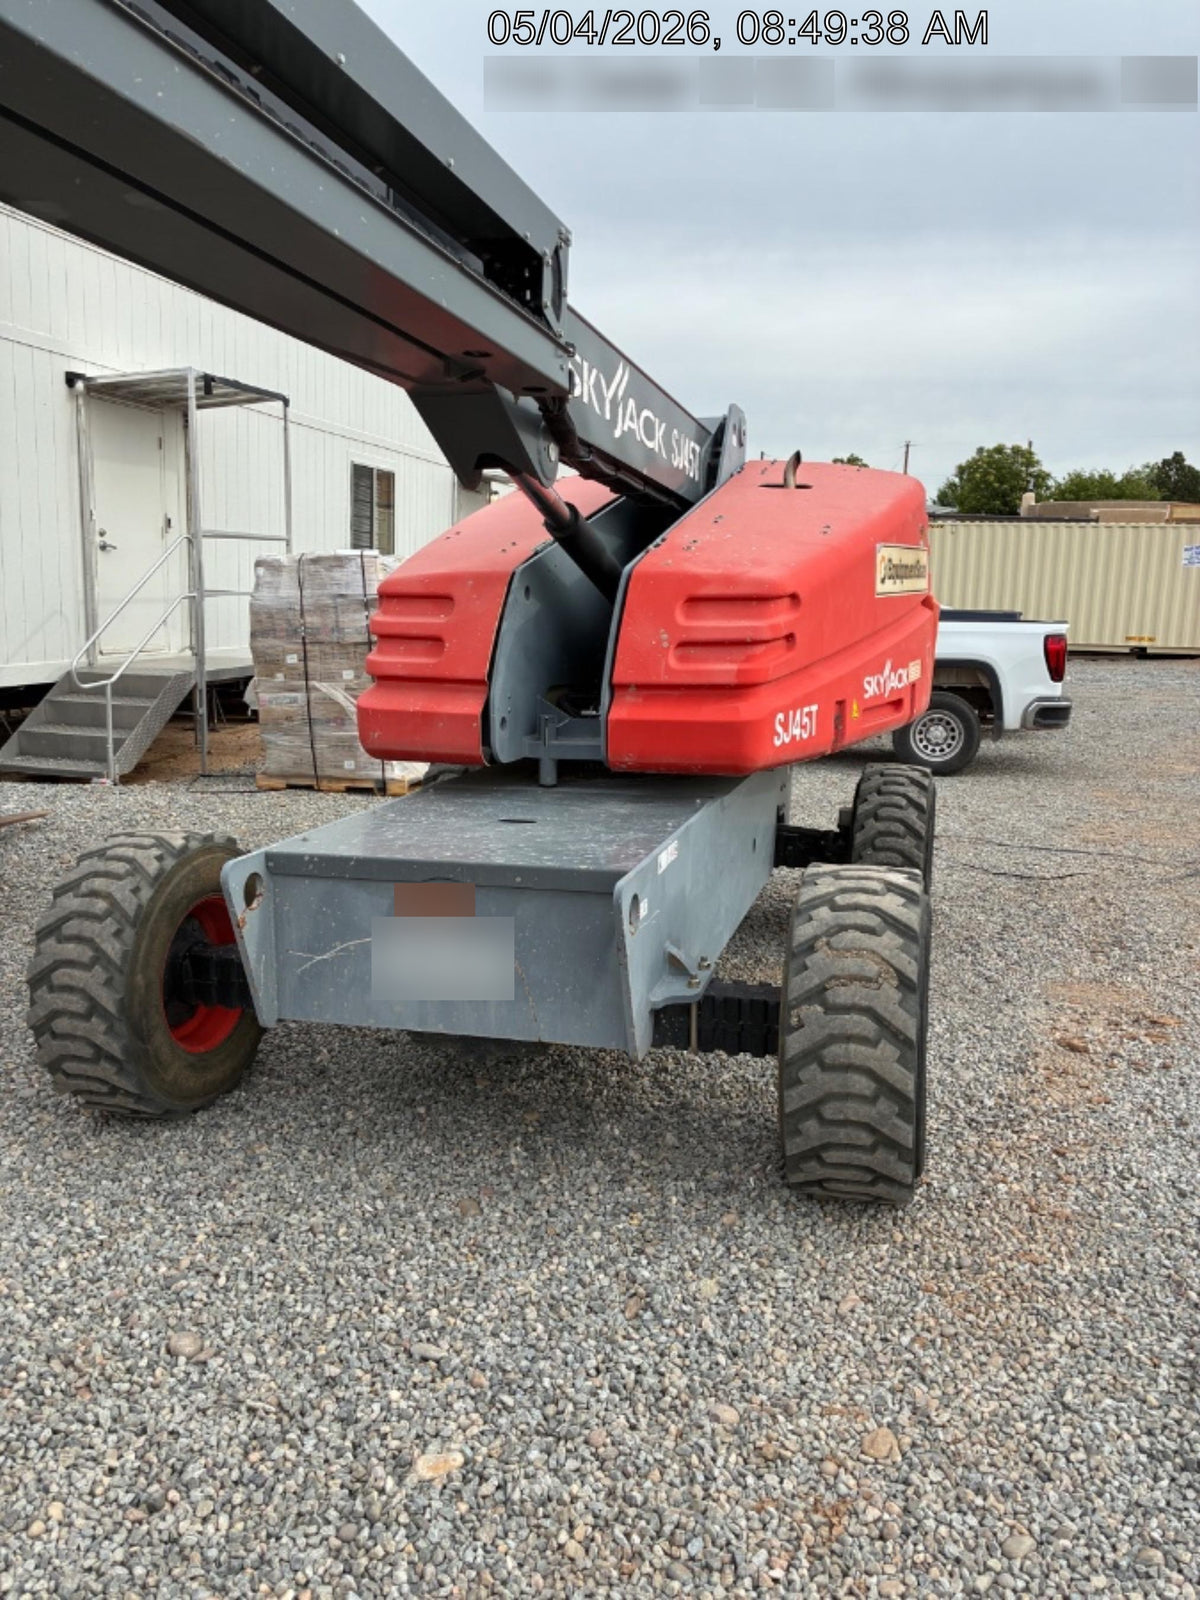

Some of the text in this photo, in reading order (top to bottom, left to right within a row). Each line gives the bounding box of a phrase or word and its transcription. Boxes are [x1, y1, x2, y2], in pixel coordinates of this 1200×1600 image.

[567, 353, 701, 482] SKYJACK SJ45T
[773, 704, 819, 747] SJ45T
